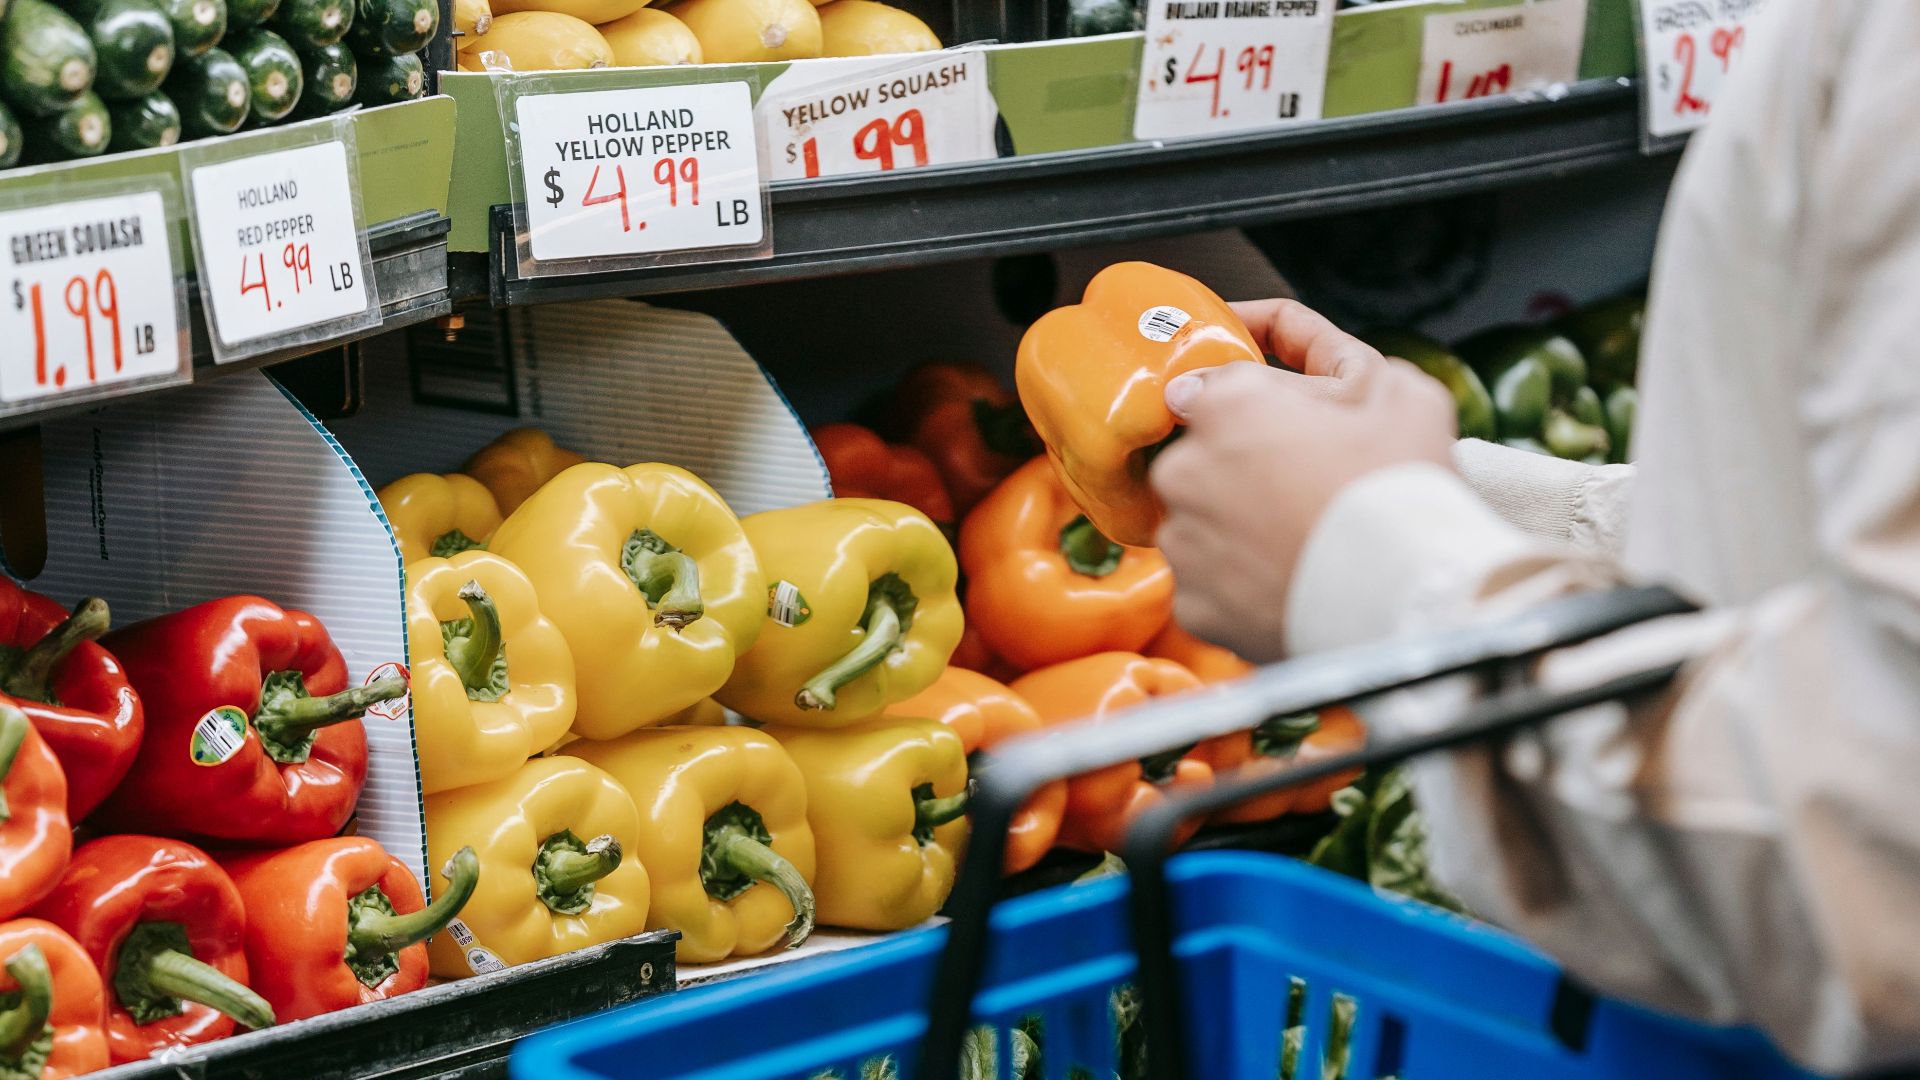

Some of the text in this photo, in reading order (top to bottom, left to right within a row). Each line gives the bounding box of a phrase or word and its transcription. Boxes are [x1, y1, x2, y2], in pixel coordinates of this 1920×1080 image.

[1164, 57, 1177, 85] $
[782, 63, 967, 127] YELLOW SQUASH
[587, 108, 694, 135] HOLLAND
[555, 130, 731, 162] YELLOW PEPPER
[786, 142, 797, 165] $
[238, 180, 298, 209] HOLLAND
[543, 157, 699, 232] $ 4.99
[716, 199, 749, 227] LB
[11, 216, 143, 264] GREEN SQUASH
[238, 214, 315, 248] RED PEPPER
[241, 242, 312, 312] 4.99
[329, 261, 354, 292] LB
[13, 267, 122, 389] $ 1.99
[135, 324, 155, 355] LB
